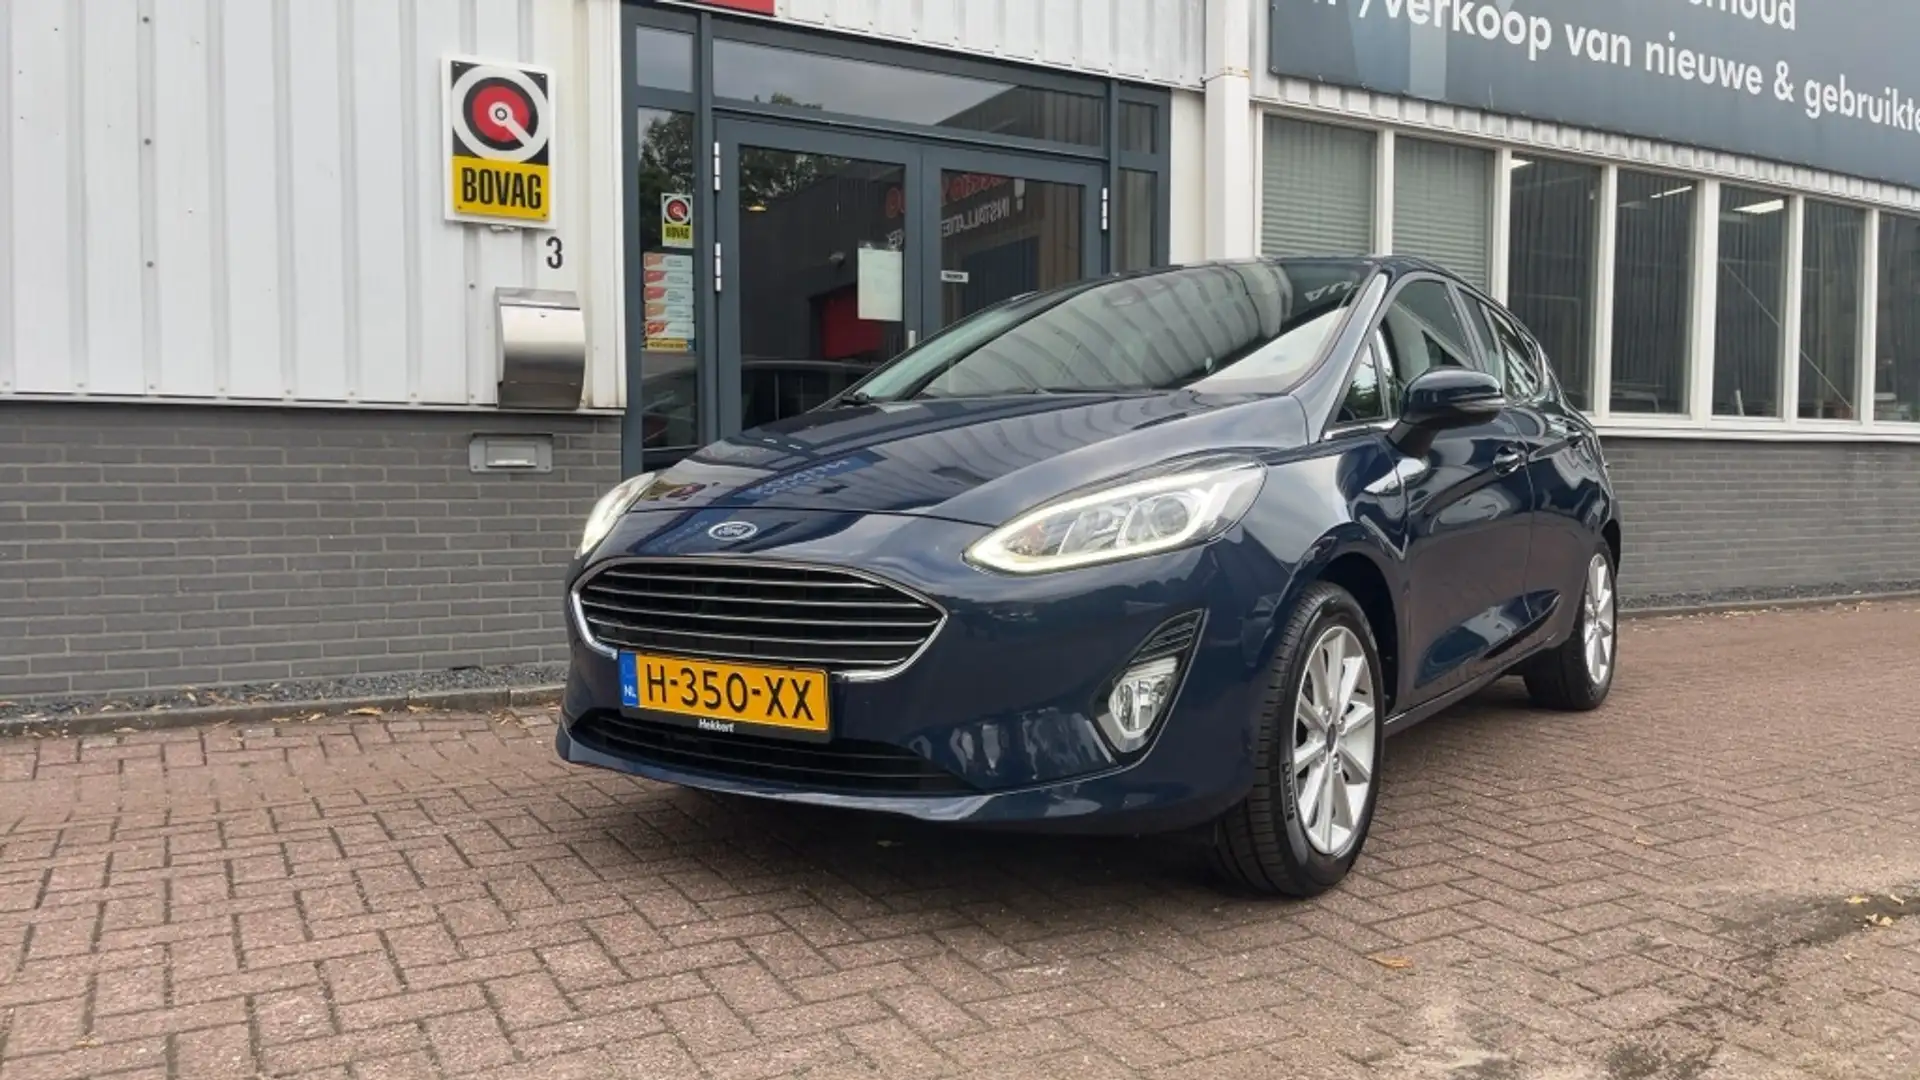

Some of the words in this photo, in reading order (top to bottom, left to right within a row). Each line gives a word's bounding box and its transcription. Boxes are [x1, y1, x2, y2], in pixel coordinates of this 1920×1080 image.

[1564, 23, 1631, 67] van
[1645, 30, 1763, 95] nieuwe
[1773, 60, 1795, 102] &
[461, 167, 542, 210] BOVAG
[665, 226, 690, 240] BOVAG
[546, 236, 563, 269] 3
[623, 684, 637, 698] NL
[646, 663, 815, 721] H-350-XX
